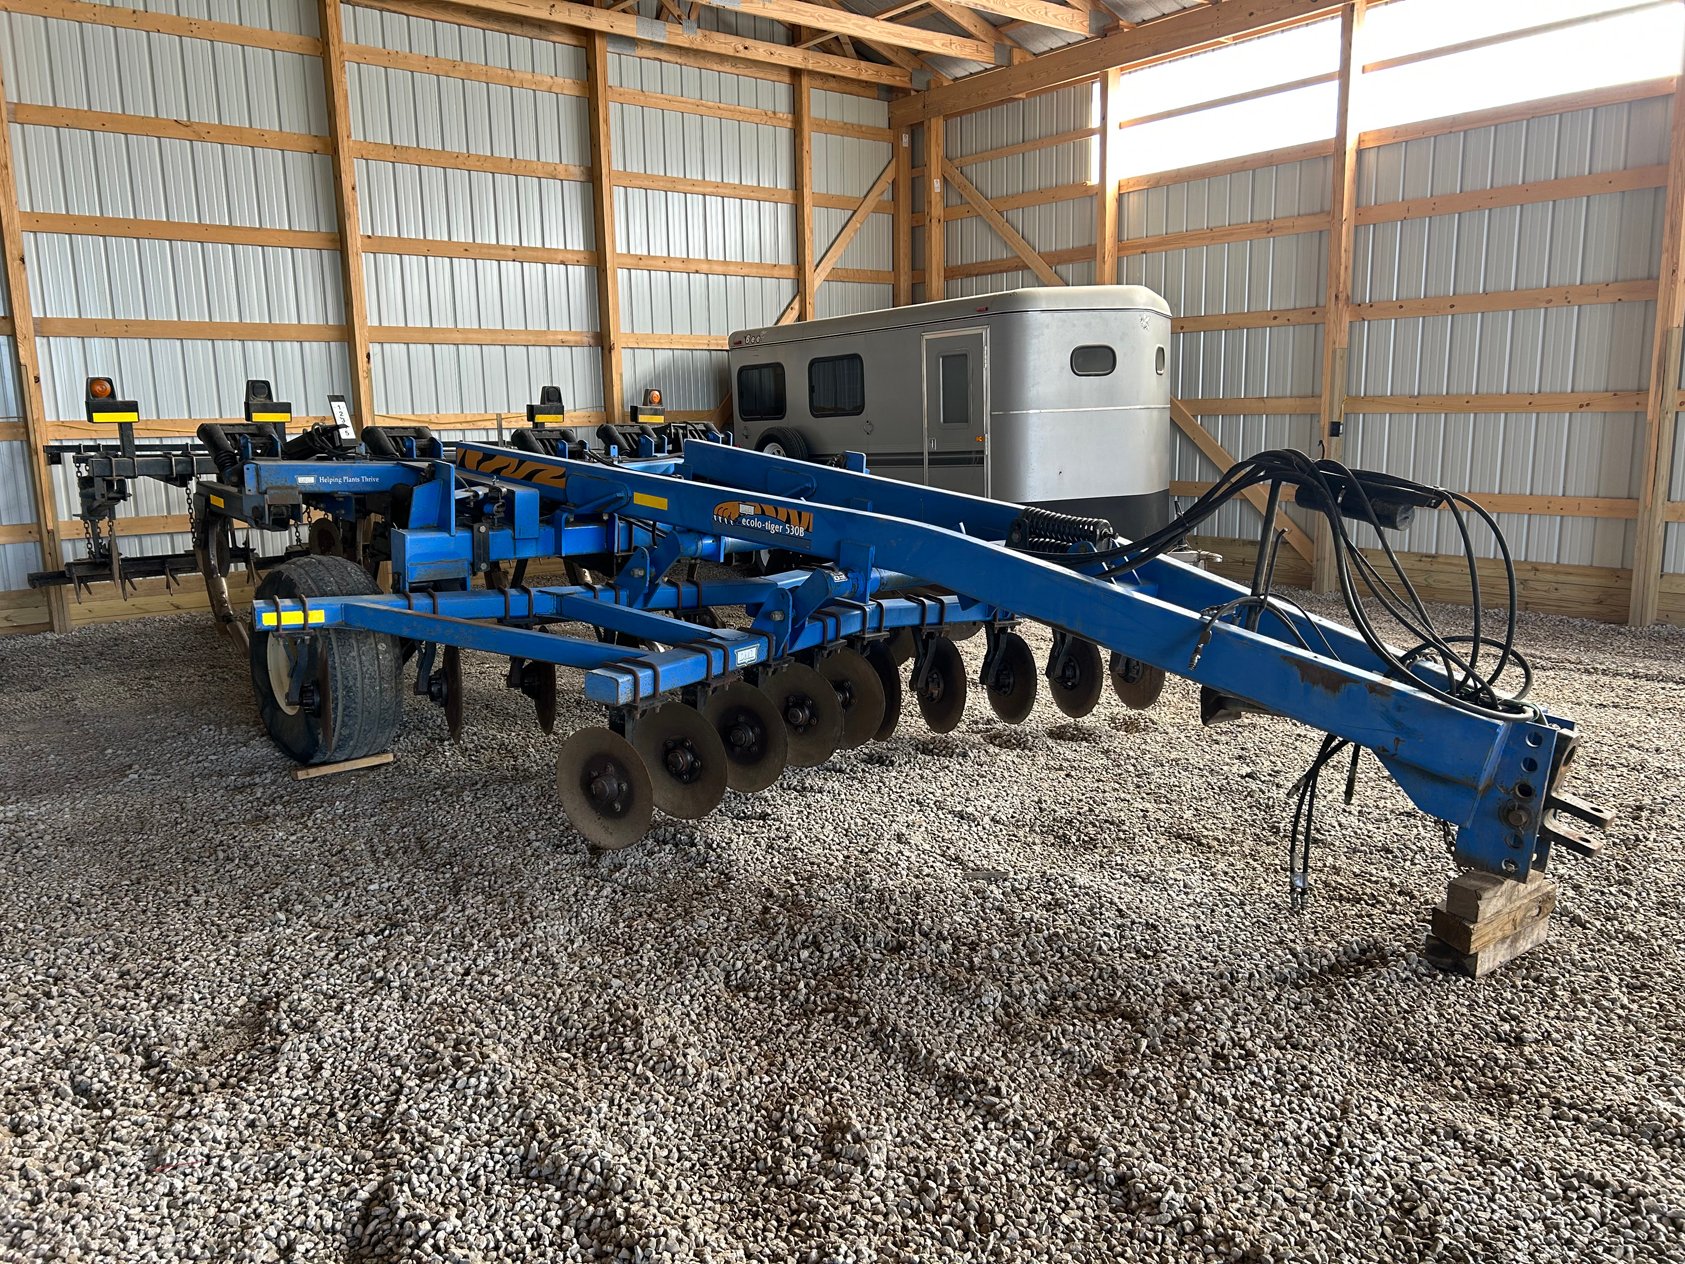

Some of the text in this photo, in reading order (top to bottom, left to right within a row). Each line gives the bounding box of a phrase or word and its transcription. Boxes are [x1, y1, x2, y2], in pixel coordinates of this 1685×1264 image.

[319, 476, 342, 485] Helping
[361, 475, 379, 483] Thrive
[741, 517, 805, 537] ecolo-tiger 530B
